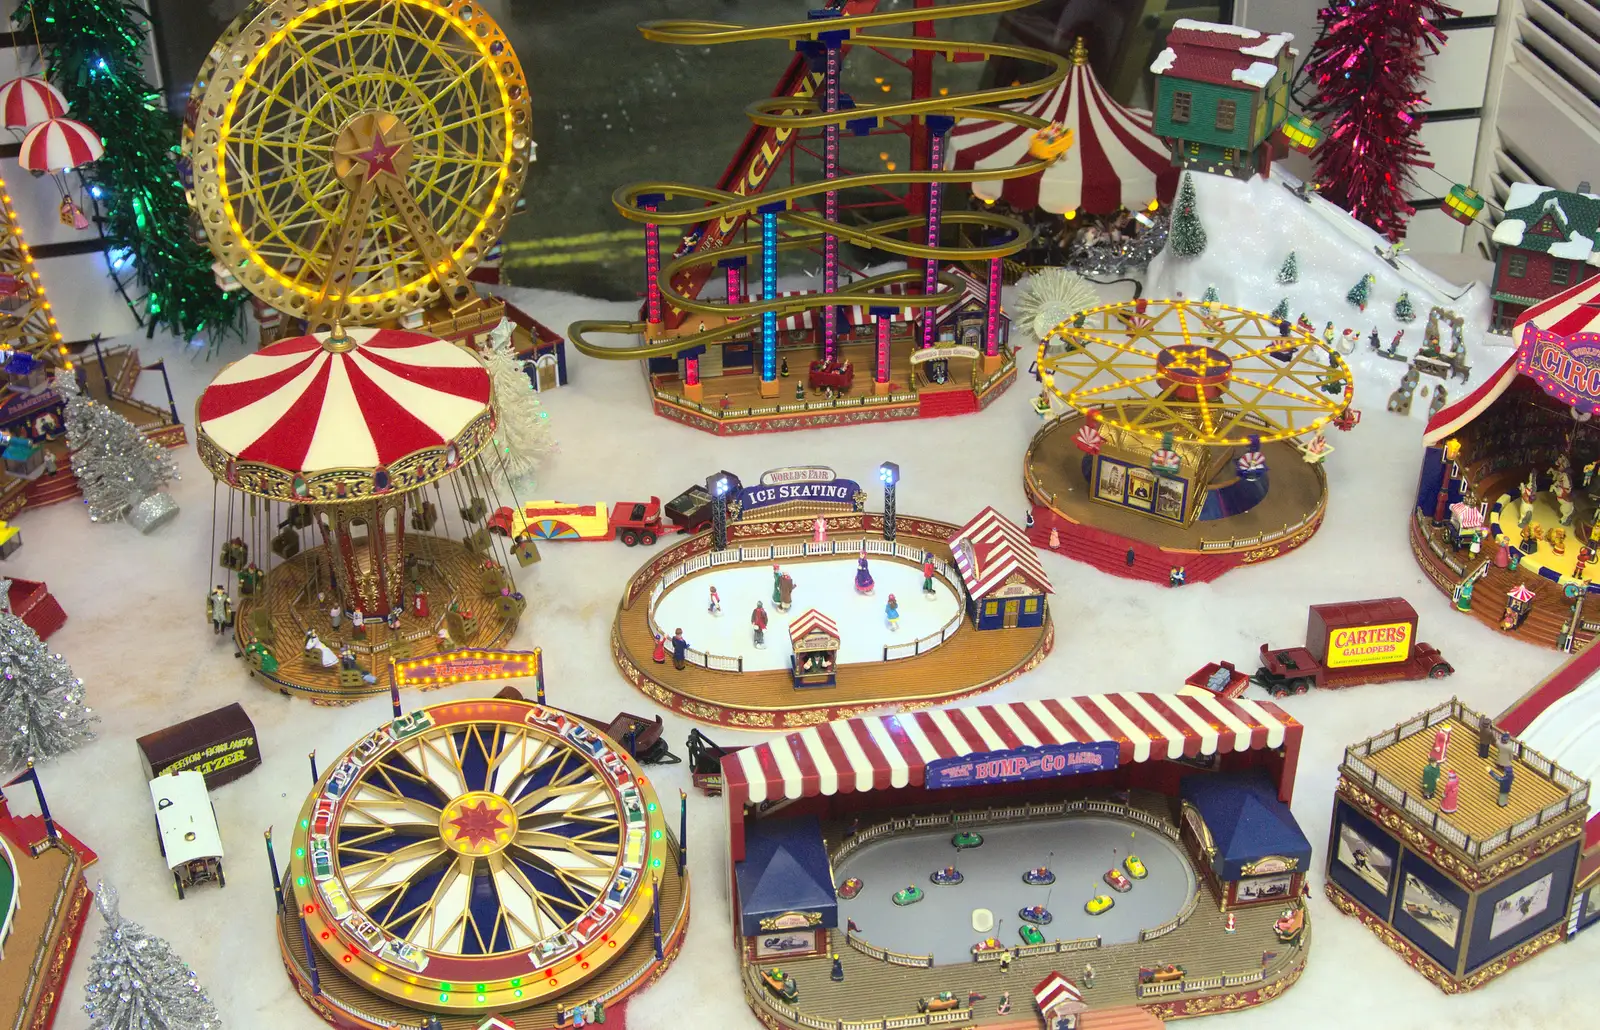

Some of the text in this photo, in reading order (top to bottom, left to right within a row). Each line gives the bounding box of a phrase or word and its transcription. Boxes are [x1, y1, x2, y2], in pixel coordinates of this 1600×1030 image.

[770, 469, 828, 482] WORLD'S FAIR
[748, 485, 848, 505] ICE SKATING
[1335, 626, 1406, 648] CARTERS
[1343, 643, 1396, 656] GALLOPERS
[188, 750, 247, 776] LTZER
[975, 757, 1027, 780] BUMP
[1040, 754, 1066, 772] GO
